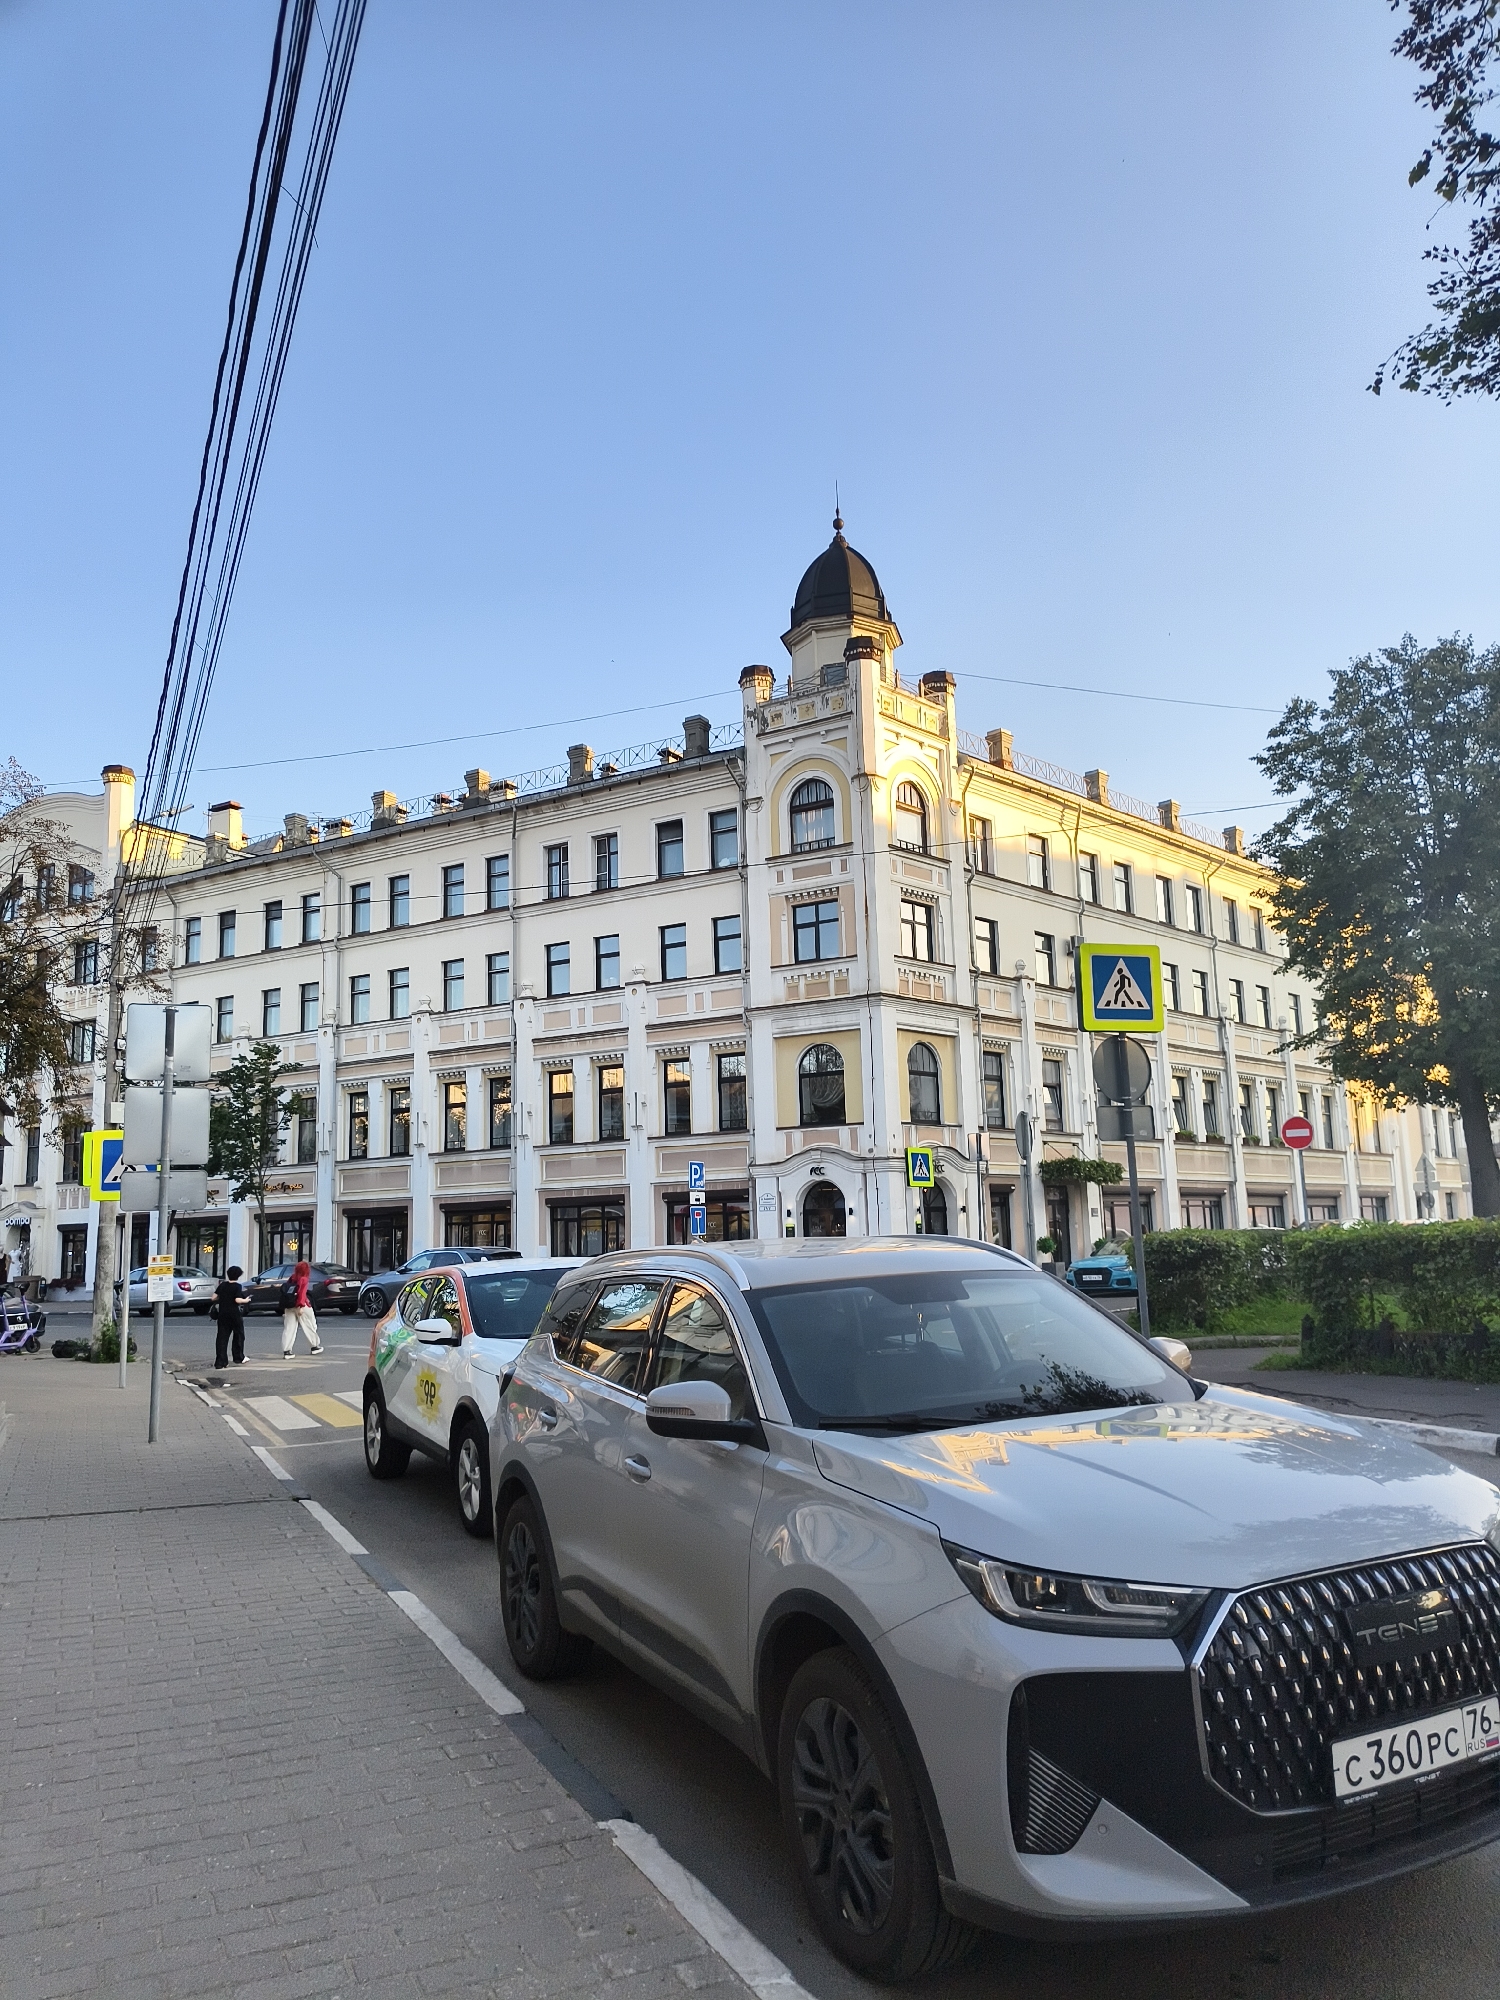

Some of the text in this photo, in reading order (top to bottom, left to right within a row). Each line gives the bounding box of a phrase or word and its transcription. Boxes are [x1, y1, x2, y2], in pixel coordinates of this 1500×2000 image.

[691, 1164, 701, 1187] P
[5, 1217, 31, 1227] pompa
[1356, 1609, 1454, 1646] TENET
[1466, 1705, 1492, 1739] 76
[1467, 1738, 1486, 1751] RUS
